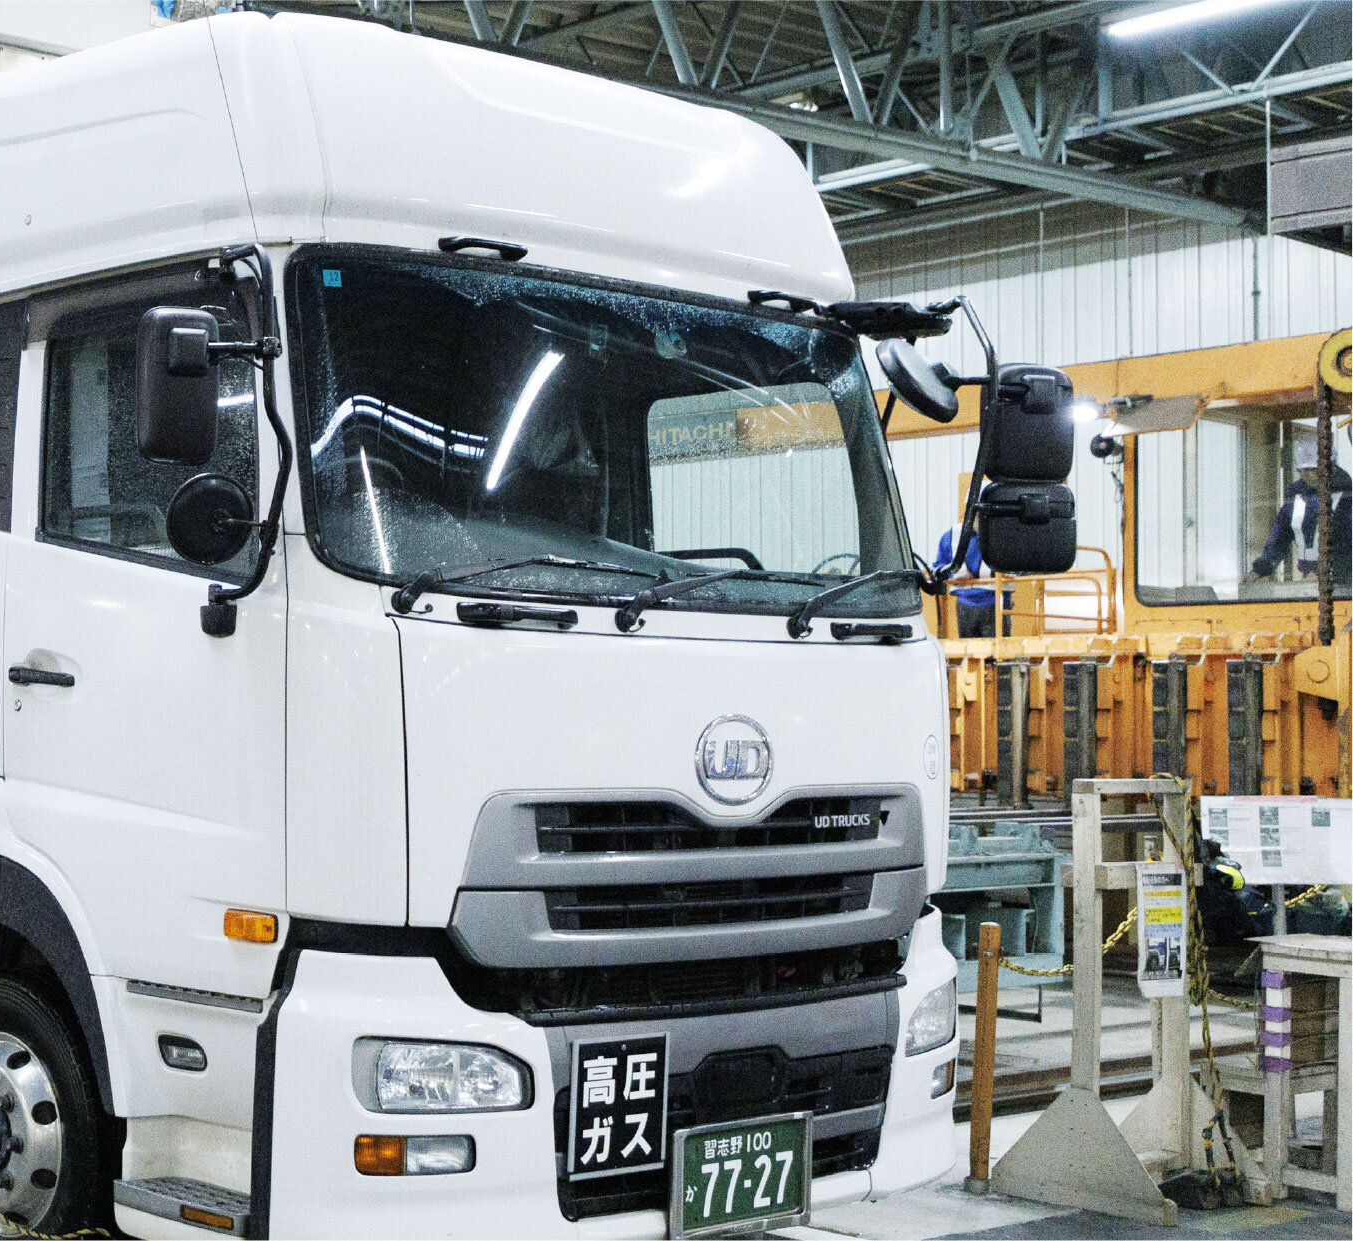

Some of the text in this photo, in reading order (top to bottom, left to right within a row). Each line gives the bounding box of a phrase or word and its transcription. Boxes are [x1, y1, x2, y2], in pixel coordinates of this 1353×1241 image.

[703, 740, 768, 780] UD
[815, 813, 871, 828] UD TRUCKS
[582, 1053, 658, 1109] 高圧
[580, 1112, 653, 1166] ガス
